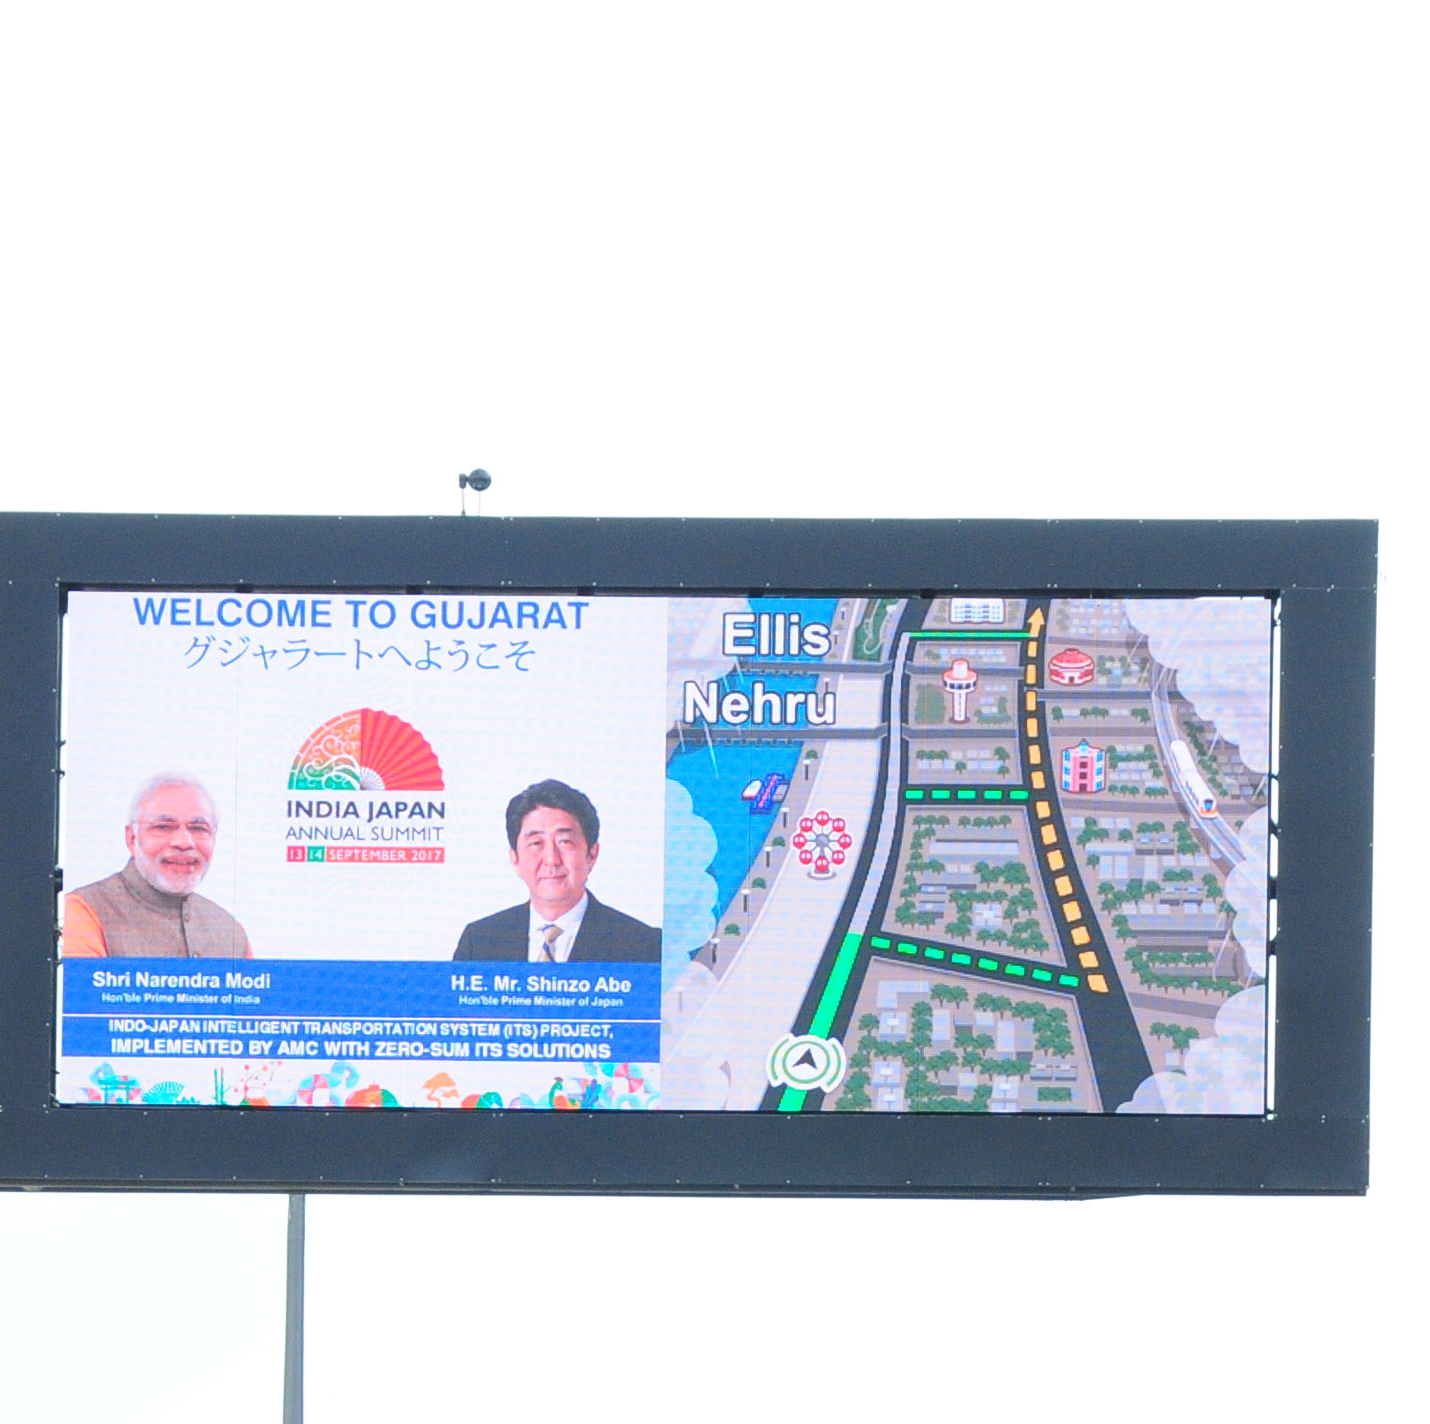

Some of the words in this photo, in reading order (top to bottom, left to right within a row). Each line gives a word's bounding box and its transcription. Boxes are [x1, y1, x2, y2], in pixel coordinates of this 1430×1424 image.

[133, 597, 332, 628] WELCOME
[350, 599, 397, 629] TO
[409, 600, 590, 630] GUJARAT
[721, 611, 832, 658] Ellis
[184, 635, 536, 673] グジャラートへようこそ
[682, 680, 837, 725] Nehru
[286, 799, 360, 819] INDIA
[366, 801, 446, 823] JAPAN
[285, 826, 365, 841] ANNUAL
[370, 826, 444, 841] SUMMIT
[289, 848, 303, 860] 13
[308, 848, 323, 860] 14
[329, 848, 407, 861] SEPTEMBER
[411, 849, 442, 861] 2017
[92, 970, 131, 989] Shri
[135, 971, 220, 989] Narendra
[225, 972, 271, 990] Modi
[450, 975, 489, 992] H.E.
[493, 975, 523, 992] Mr.
[526, 975, 590, 993] Shinzo
[594, 976, 632, 993] Abe
[101, 992, 142, 1004] Hon'ble
[143, 992, 175, 1004] Prime
[176, 993, 219, 1005] Minister
[220, 993, 233, 1005] of
[233, 994, 261, 1005] India
[458, 995, 499, 1006] Hon'ble
[501, 995, 532, 1006] Prime
[533, 995, 576, 1007] Minister
[578, 996, 589, 1007] of
[590, 996, 624, 1008] Japan
[108, 1018, 201, 1033] INDO-JAPAN
[202, 1019, 300, 1035] INTELLIGENT
[302, 1020, 438, 1037] TRANSPORTATION
[440, 1022, 501, 1037] SYSTEM
[503, 1023, 539, 1040] (ITS)
[540, 1023, 614, 1040] PROJECT,
[110, 1038, 244, 1055] IMPLEMENTED
[248, 1039, 273, 1056] BY
[277, 1040, 319, 1056] AMC
[323, 1041, 370, 1057] WITH
[374, 1041, 471, 1058] ZERO-SUM
[474, 1042, 504, 1058] ITS
[506, 1042, 612, 1059] SOLUTIONS
